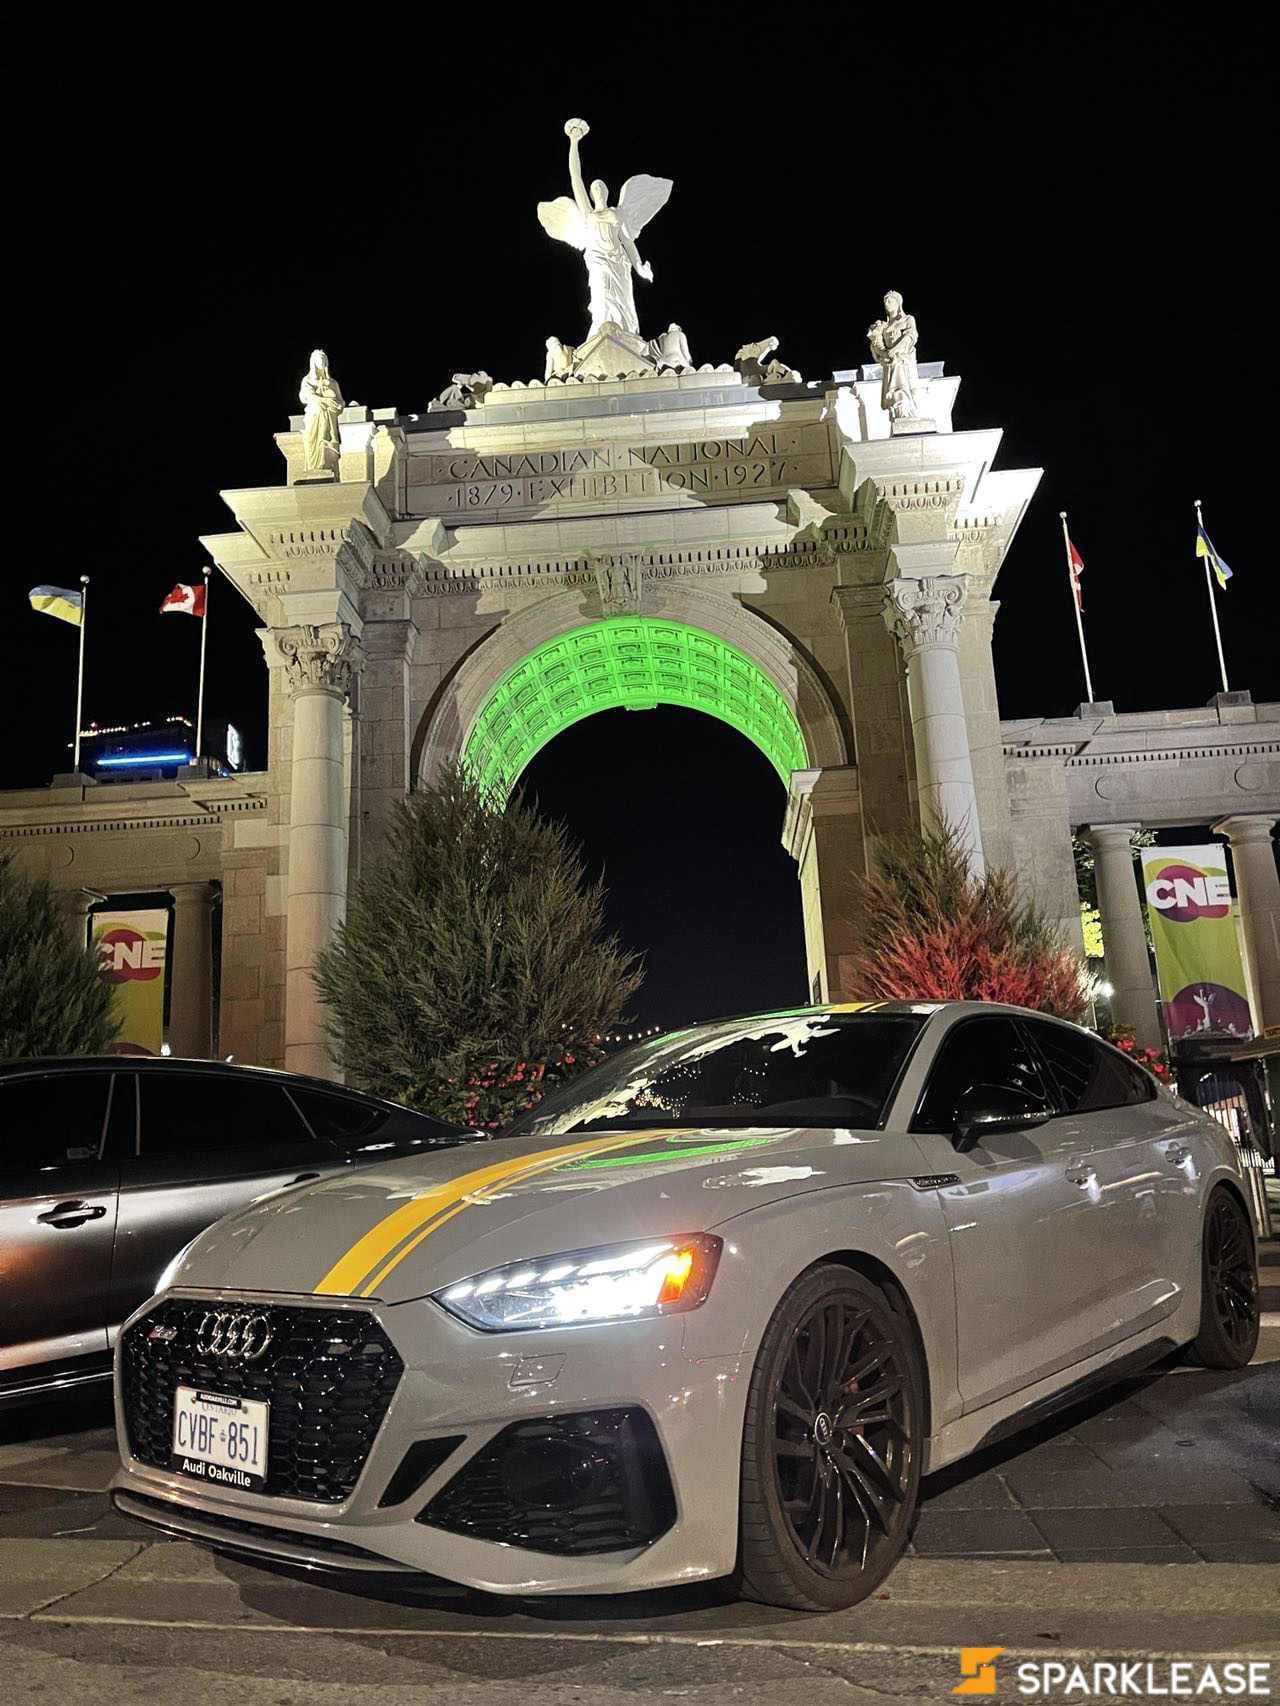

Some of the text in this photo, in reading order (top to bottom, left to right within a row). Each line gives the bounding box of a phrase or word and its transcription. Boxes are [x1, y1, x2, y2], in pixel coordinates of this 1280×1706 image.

[449, 435, 788, 479] CANADIAN NATIONAL
[456, 484, 513, 507] 1879
[725, 461, 787, 486] 1927
[1146, 876, 1232, 909] CNE
[178, 1411, 258, 1466] CVBF 851
[182, 1458, 251, 1487] Audi Oakville
